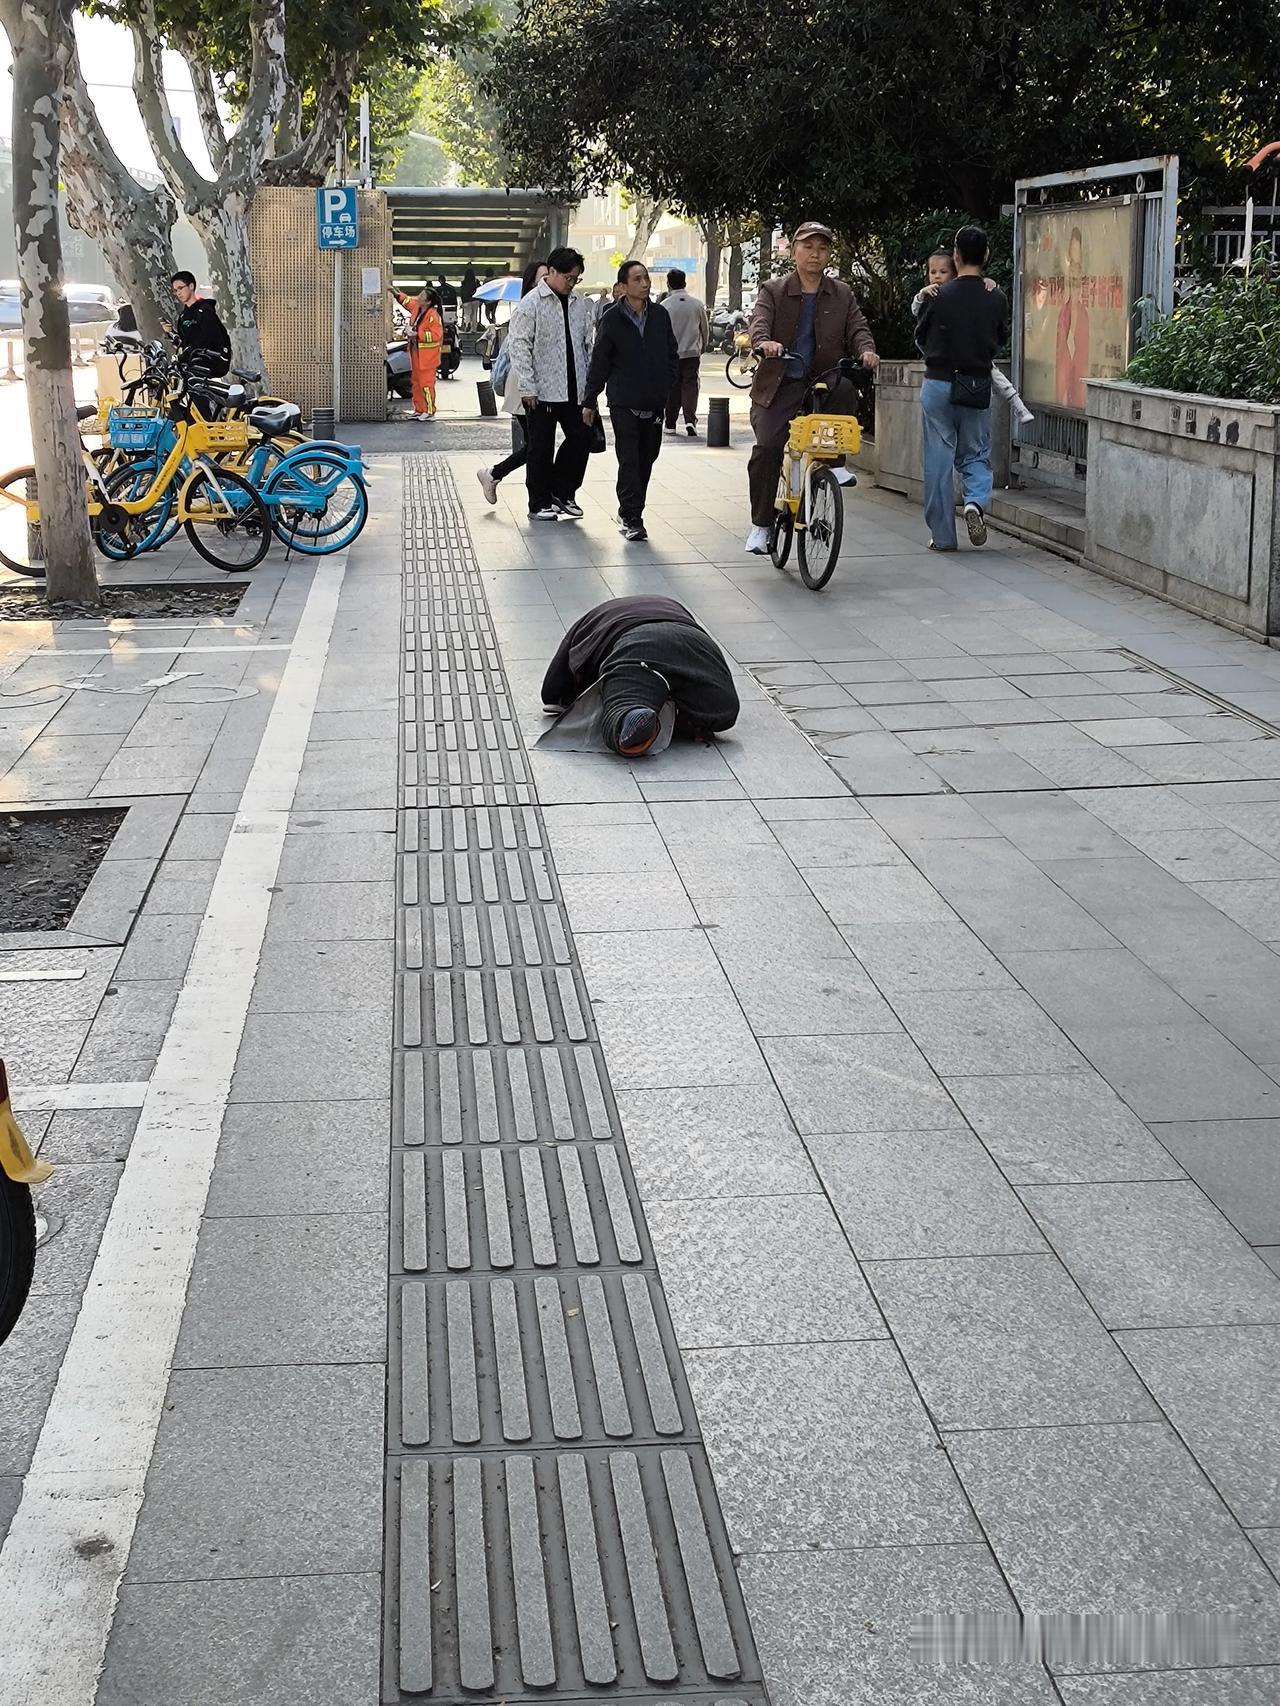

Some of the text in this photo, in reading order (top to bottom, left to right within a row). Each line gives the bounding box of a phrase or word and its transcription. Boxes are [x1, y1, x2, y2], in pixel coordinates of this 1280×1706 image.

[324, 189, 347, 223] P
[321, 226, 355, 239] 停车场
